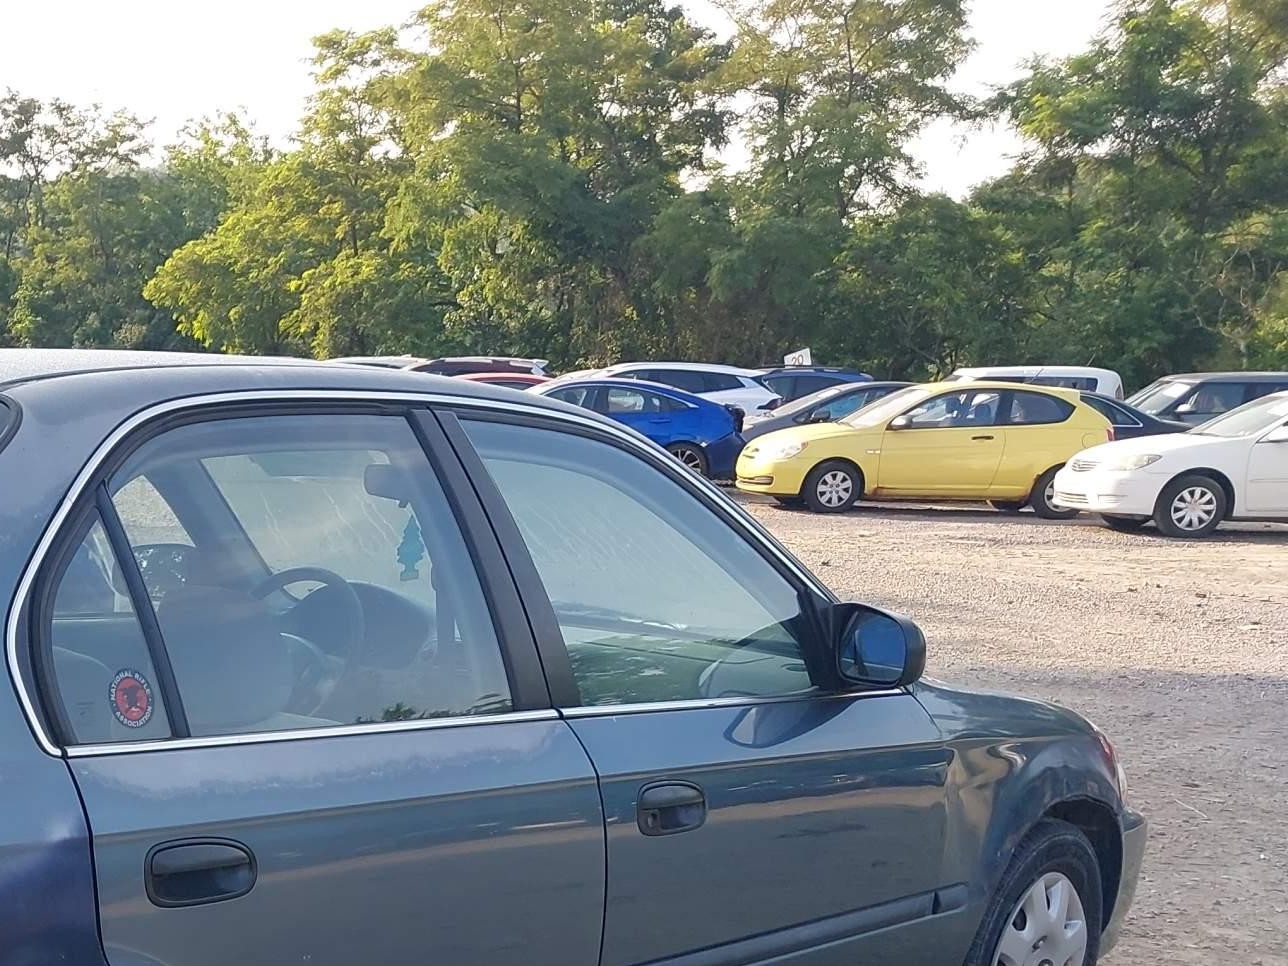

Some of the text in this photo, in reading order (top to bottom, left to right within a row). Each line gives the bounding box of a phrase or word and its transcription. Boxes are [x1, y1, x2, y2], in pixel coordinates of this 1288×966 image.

[110, 672, 151, 701] NATIONAL RIFLE
[115, 706, 152, 726] ASSOCIATION
